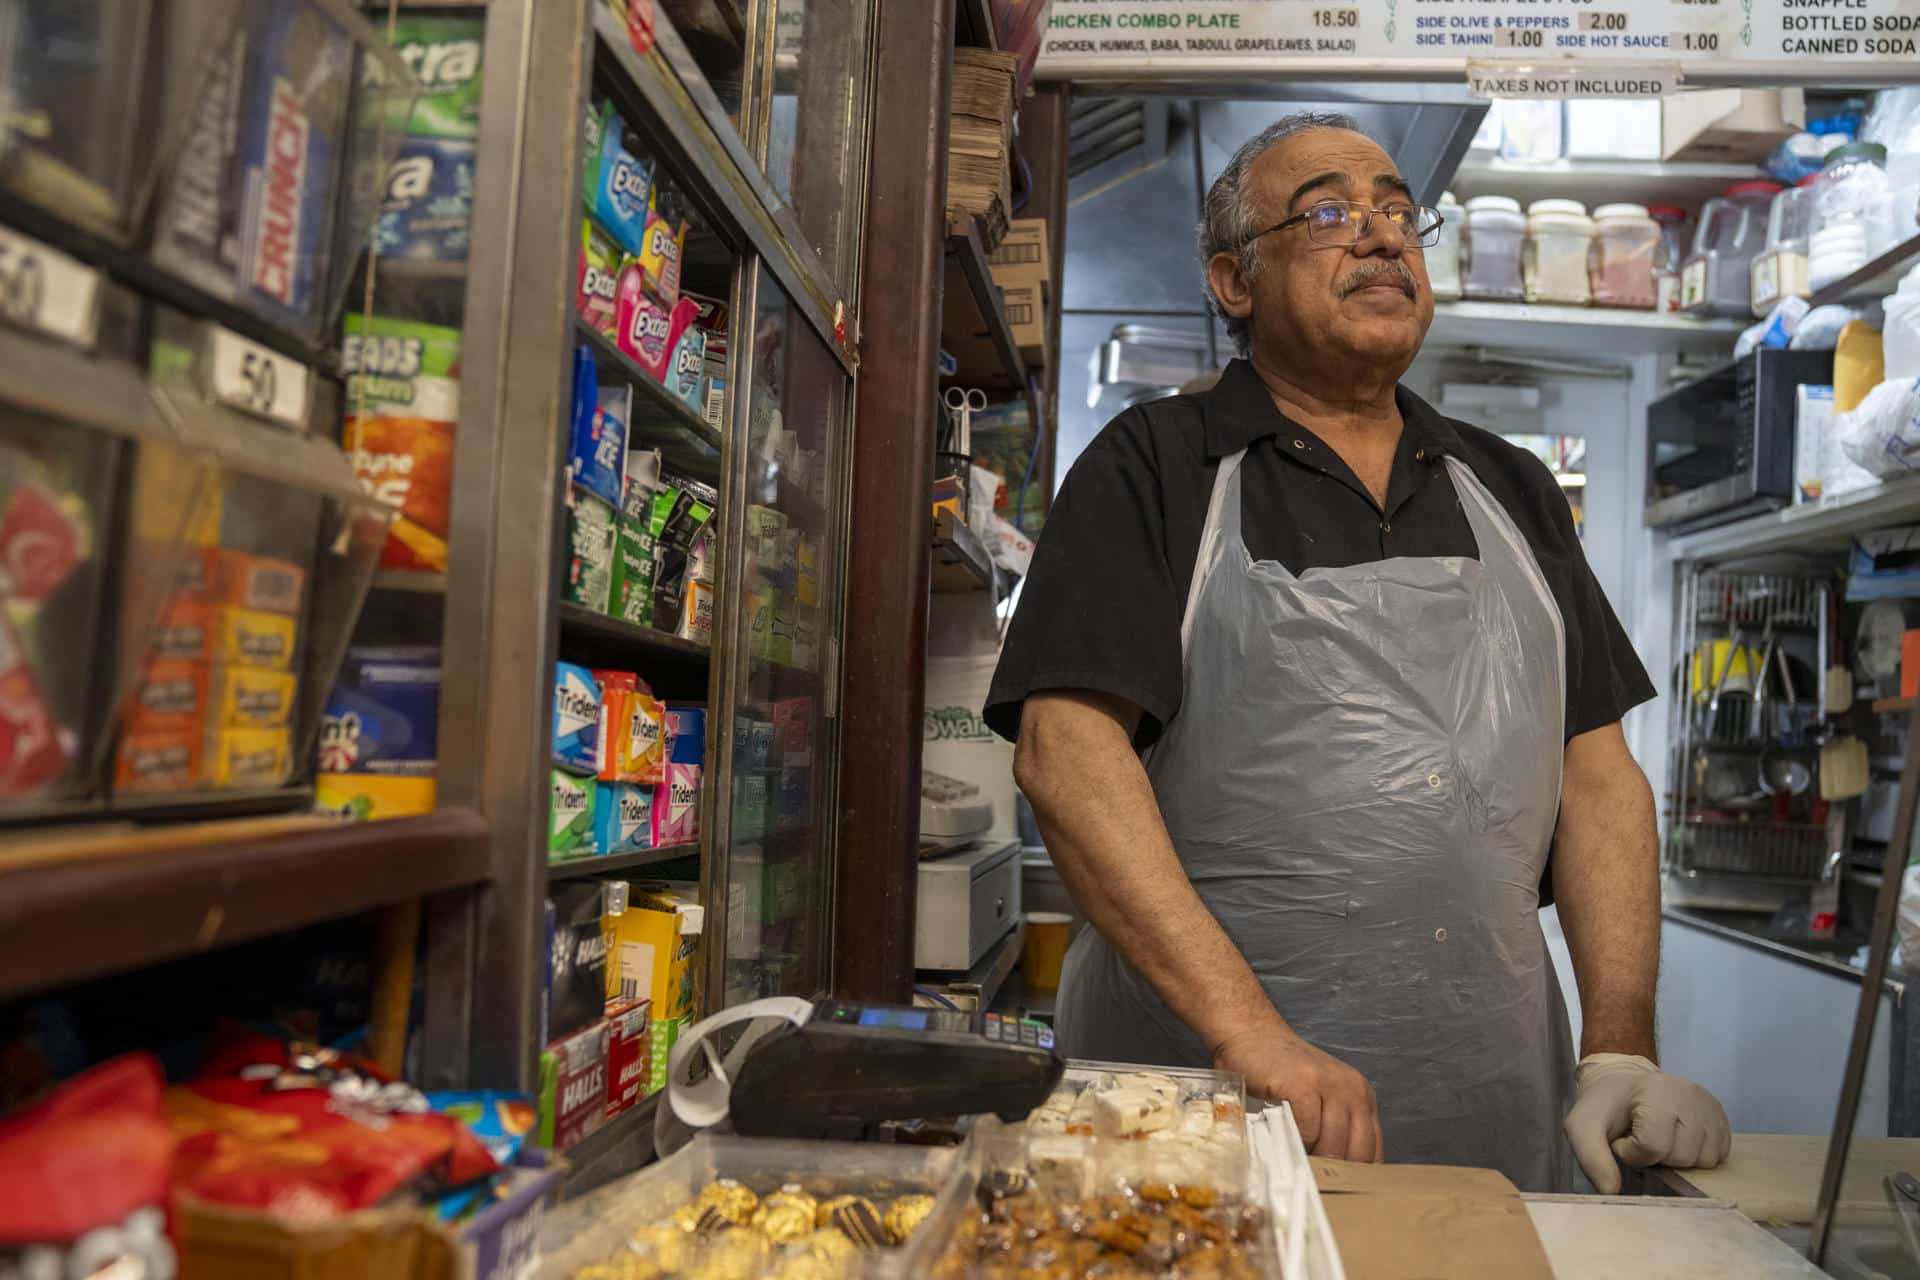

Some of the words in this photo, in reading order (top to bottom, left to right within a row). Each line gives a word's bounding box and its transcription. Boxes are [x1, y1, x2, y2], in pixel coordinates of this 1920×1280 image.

[1048, 14, 1112, 28] HICKEN
[1117, 14, 1181, 28] COMBO
[1186, 14, 1240, 28] PLATE
[1313, 11, 1357, 27] 18.50
[1416, 16, 1446, 28] SIDE
[1450, 16, 1489, 28] OLIVE
[1494, 16, 1503, 28] &
[1507, 16, 1569, 28] PEPPERS
[1591, 14, 1626, 30] 2.00
[1783, 16, 1866, 31] BOTTLED
[1873, 16, 1920, 31] SODA
[1317, 39, 1356, 51] SALAD)
[1416, 33, 1446, 45] SIDE
[1451, 33, 1493, 45] TAHINI
[1508, 31, 1542, 47] 1.00
[1556, 35, 1586, 47] SIDE
[1591, 36, 1619, 47] HOT
[1623, 35, 1669, 47] SAUCE
[1684, 34, 1718, 50] 1.00
[1782, 38, 1858, 53] CANNED
[1864, 38, 1917, 54] SODA
[1473, 79, 1529, 92] TAXES
[1535, 80, 1569, 93] NOT
[1575, 80, 1662, 94] INCLUDED
[258, 91, 305, 303] CRUNCH
[344, 336, 421, 377] EADS
[560, 687, 599, 720] Triden
[632, 714, 660, 740] Trident
[620, 1056, 644, 1085] HALLS
[562, 1064, 604, 1116] HALLS
